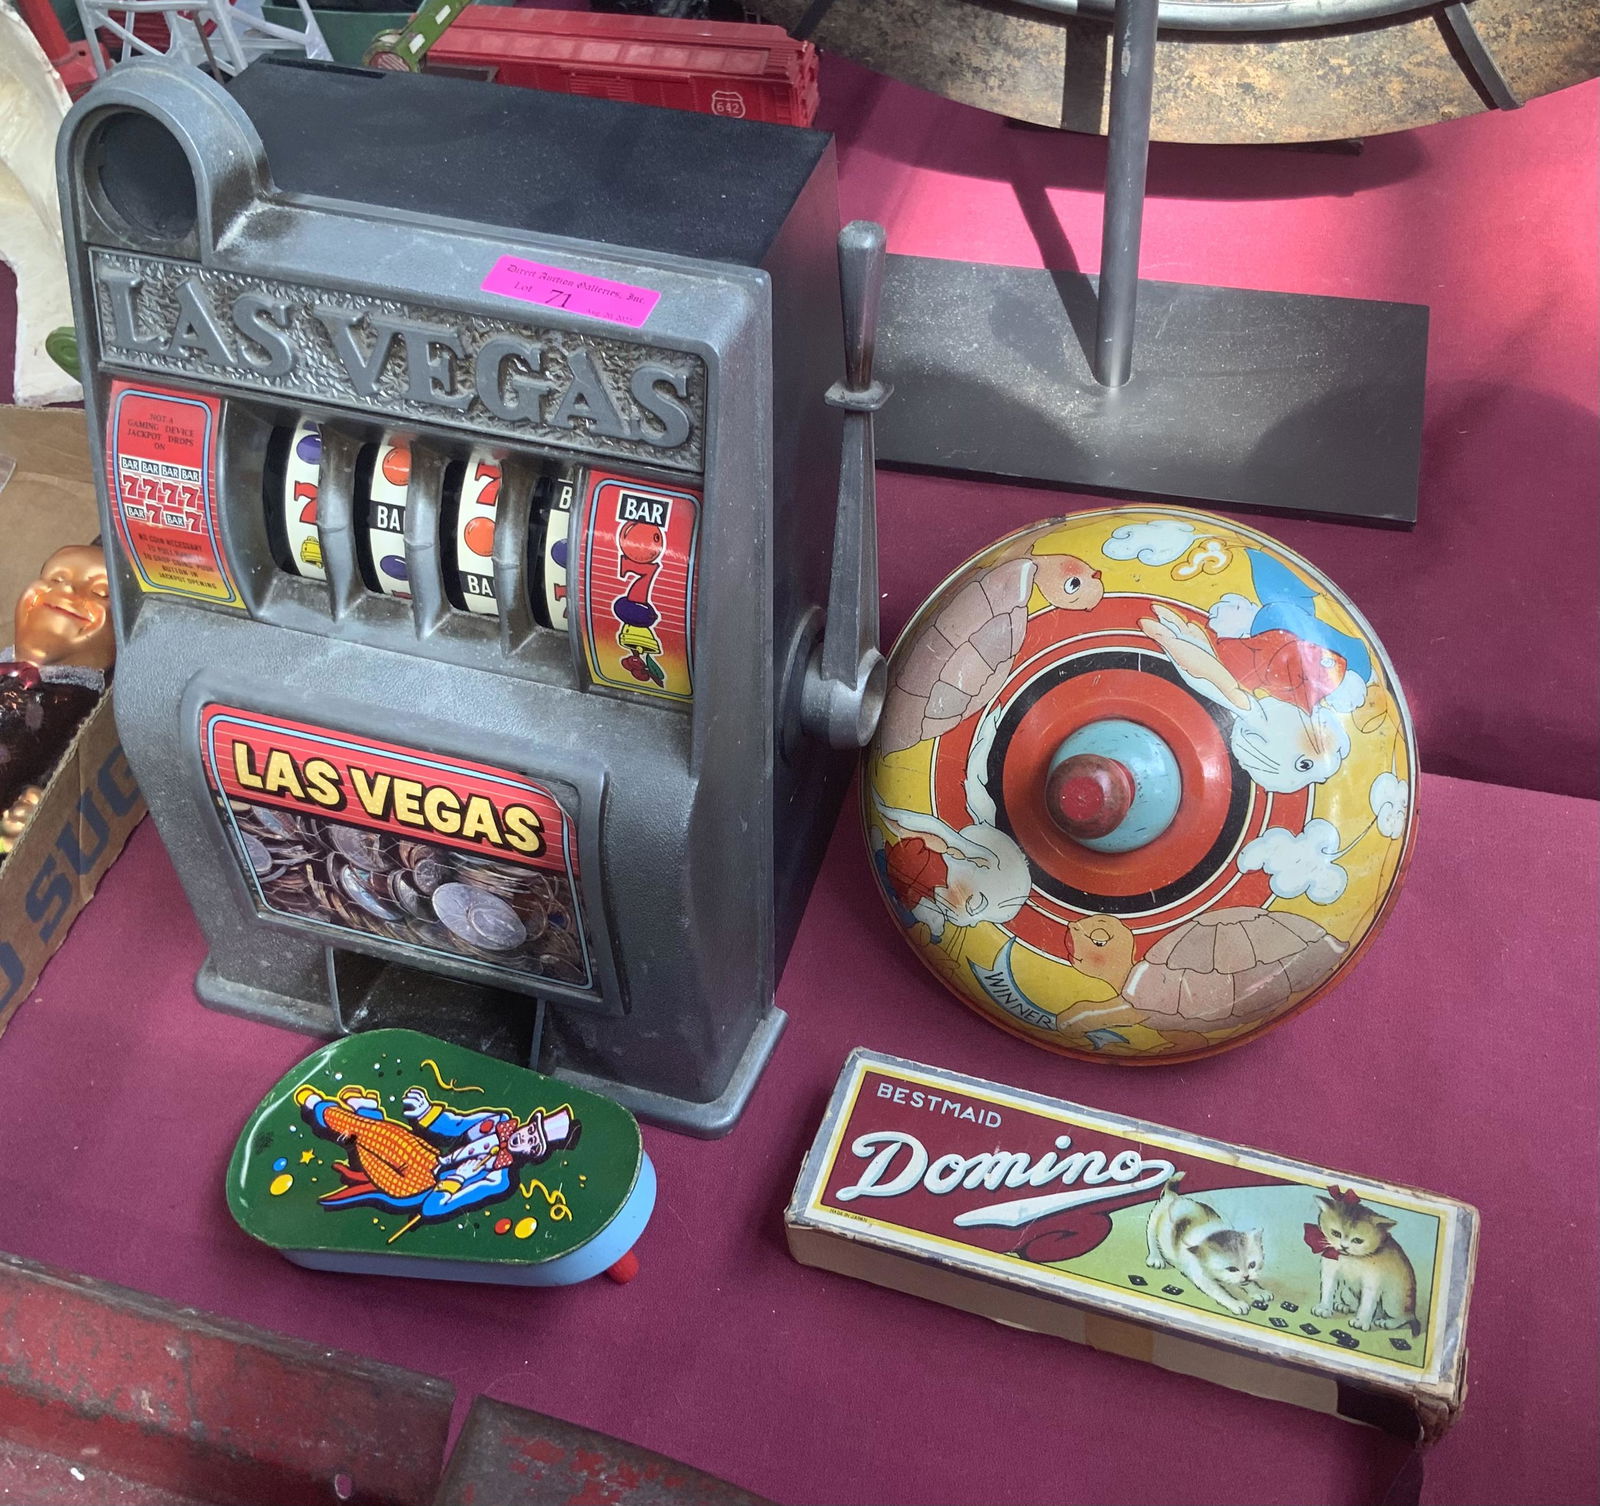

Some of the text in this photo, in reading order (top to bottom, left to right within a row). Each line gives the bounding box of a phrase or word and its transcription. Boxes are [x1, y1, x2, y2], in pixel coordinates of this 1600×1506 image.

[716, 101, 740, 114] 642
[514, 281, 572, 308] Lot 71
[99, 269, 694, 448] LAS VEGAS
[127, 419, 194, 437] GAMING DEVICE
[128, 428, 194, 447] JACKPOT DROPS
[154, 442, 166, 450] ON
[122, 458, 199, 482] BAR BAR BAR BAR
[128, 507, 145, 519] BAR
[167, 515, 184, 526] BAR
[377, 504, 406, 532] BA
[624, 497, 664, 525] BAR
[467, 574, 496, 598] BA
[232, 739, 547, 857] LAS VEGAS
[985, 972, 1055, 1029] WINNER
[876, 1082, 1002, 1129] BESTMAID
[835, 1130, 1175, 1214] Domino
